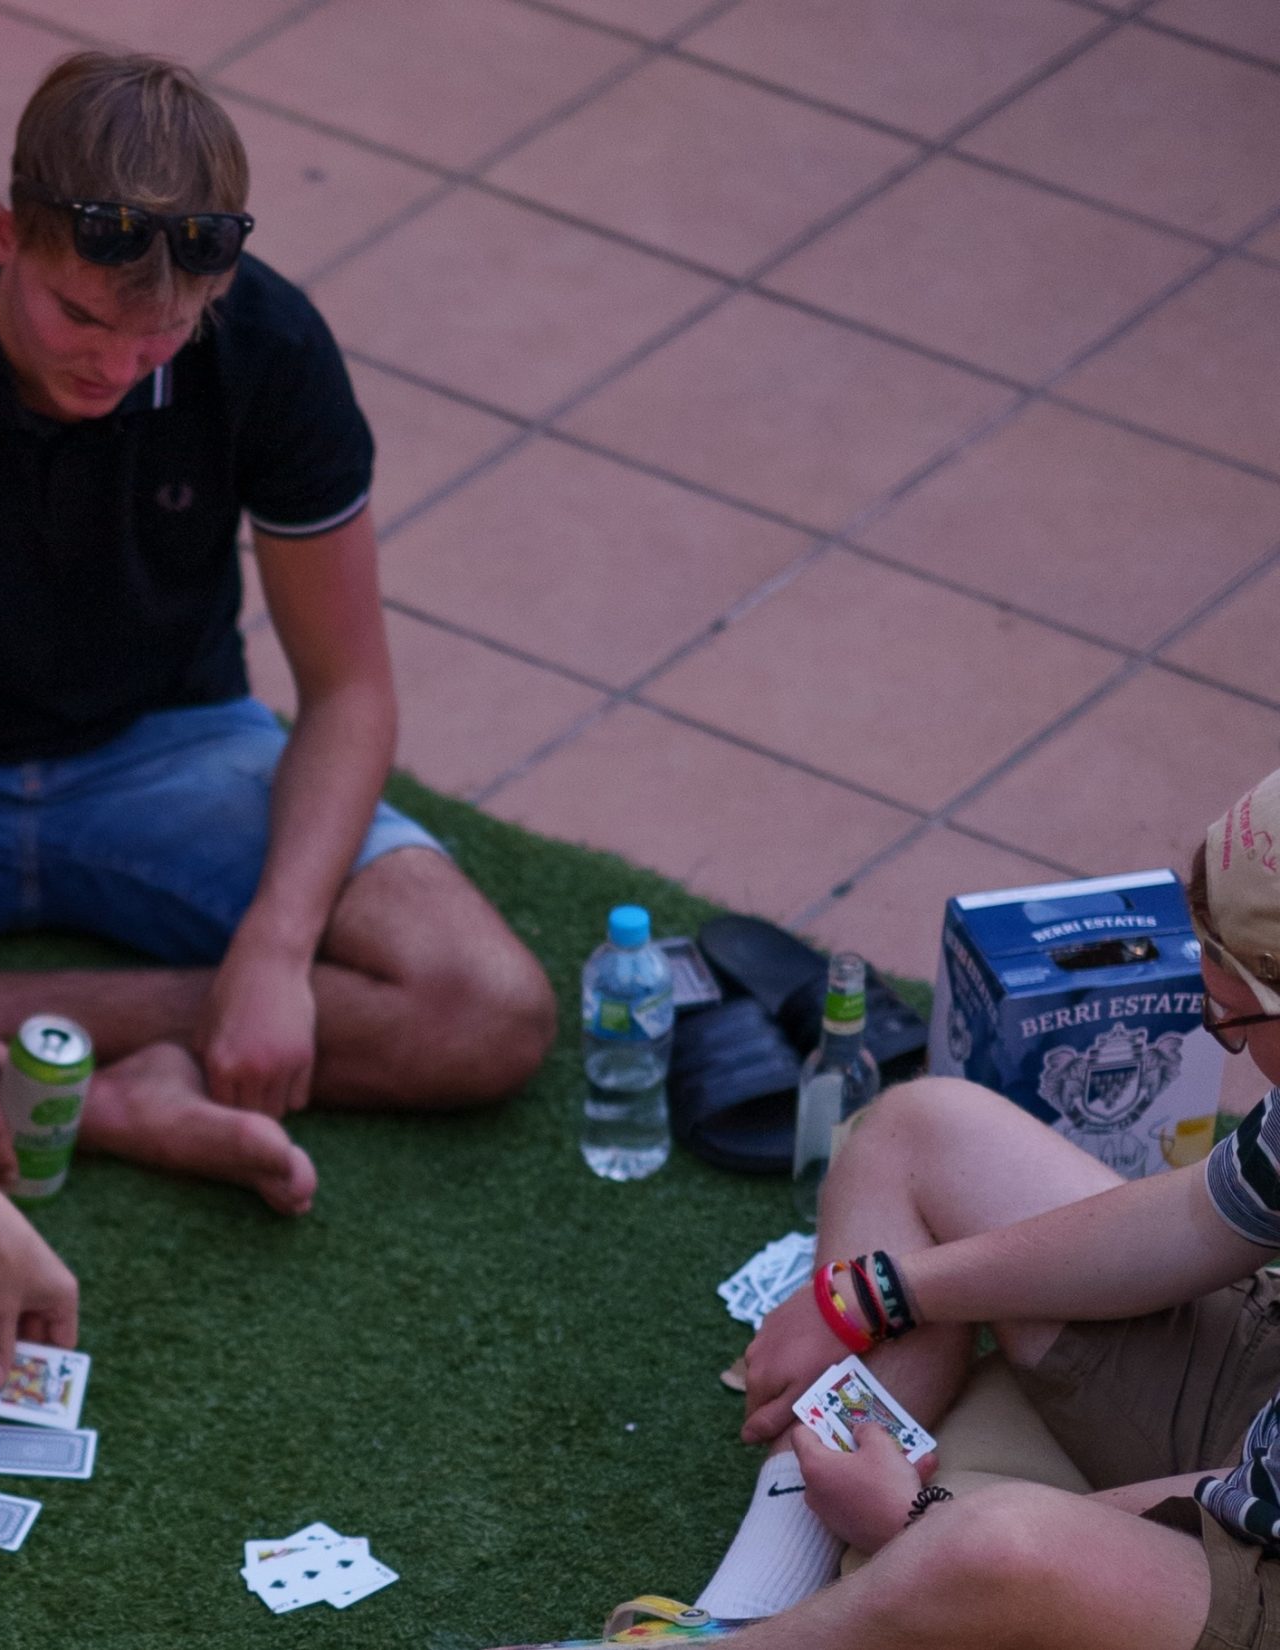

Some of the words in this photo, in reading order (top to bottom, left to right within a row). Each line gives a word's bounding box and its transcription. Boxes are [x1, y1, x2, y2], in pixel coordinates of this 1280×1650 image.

[1031, 921, 1081, 943] BERRI
[1084, 915, 1157, 930] ESTATES
[1021, 1003, 1100, 1038] BERRI
[1109, 992, 1204, 1017] ESTATE
